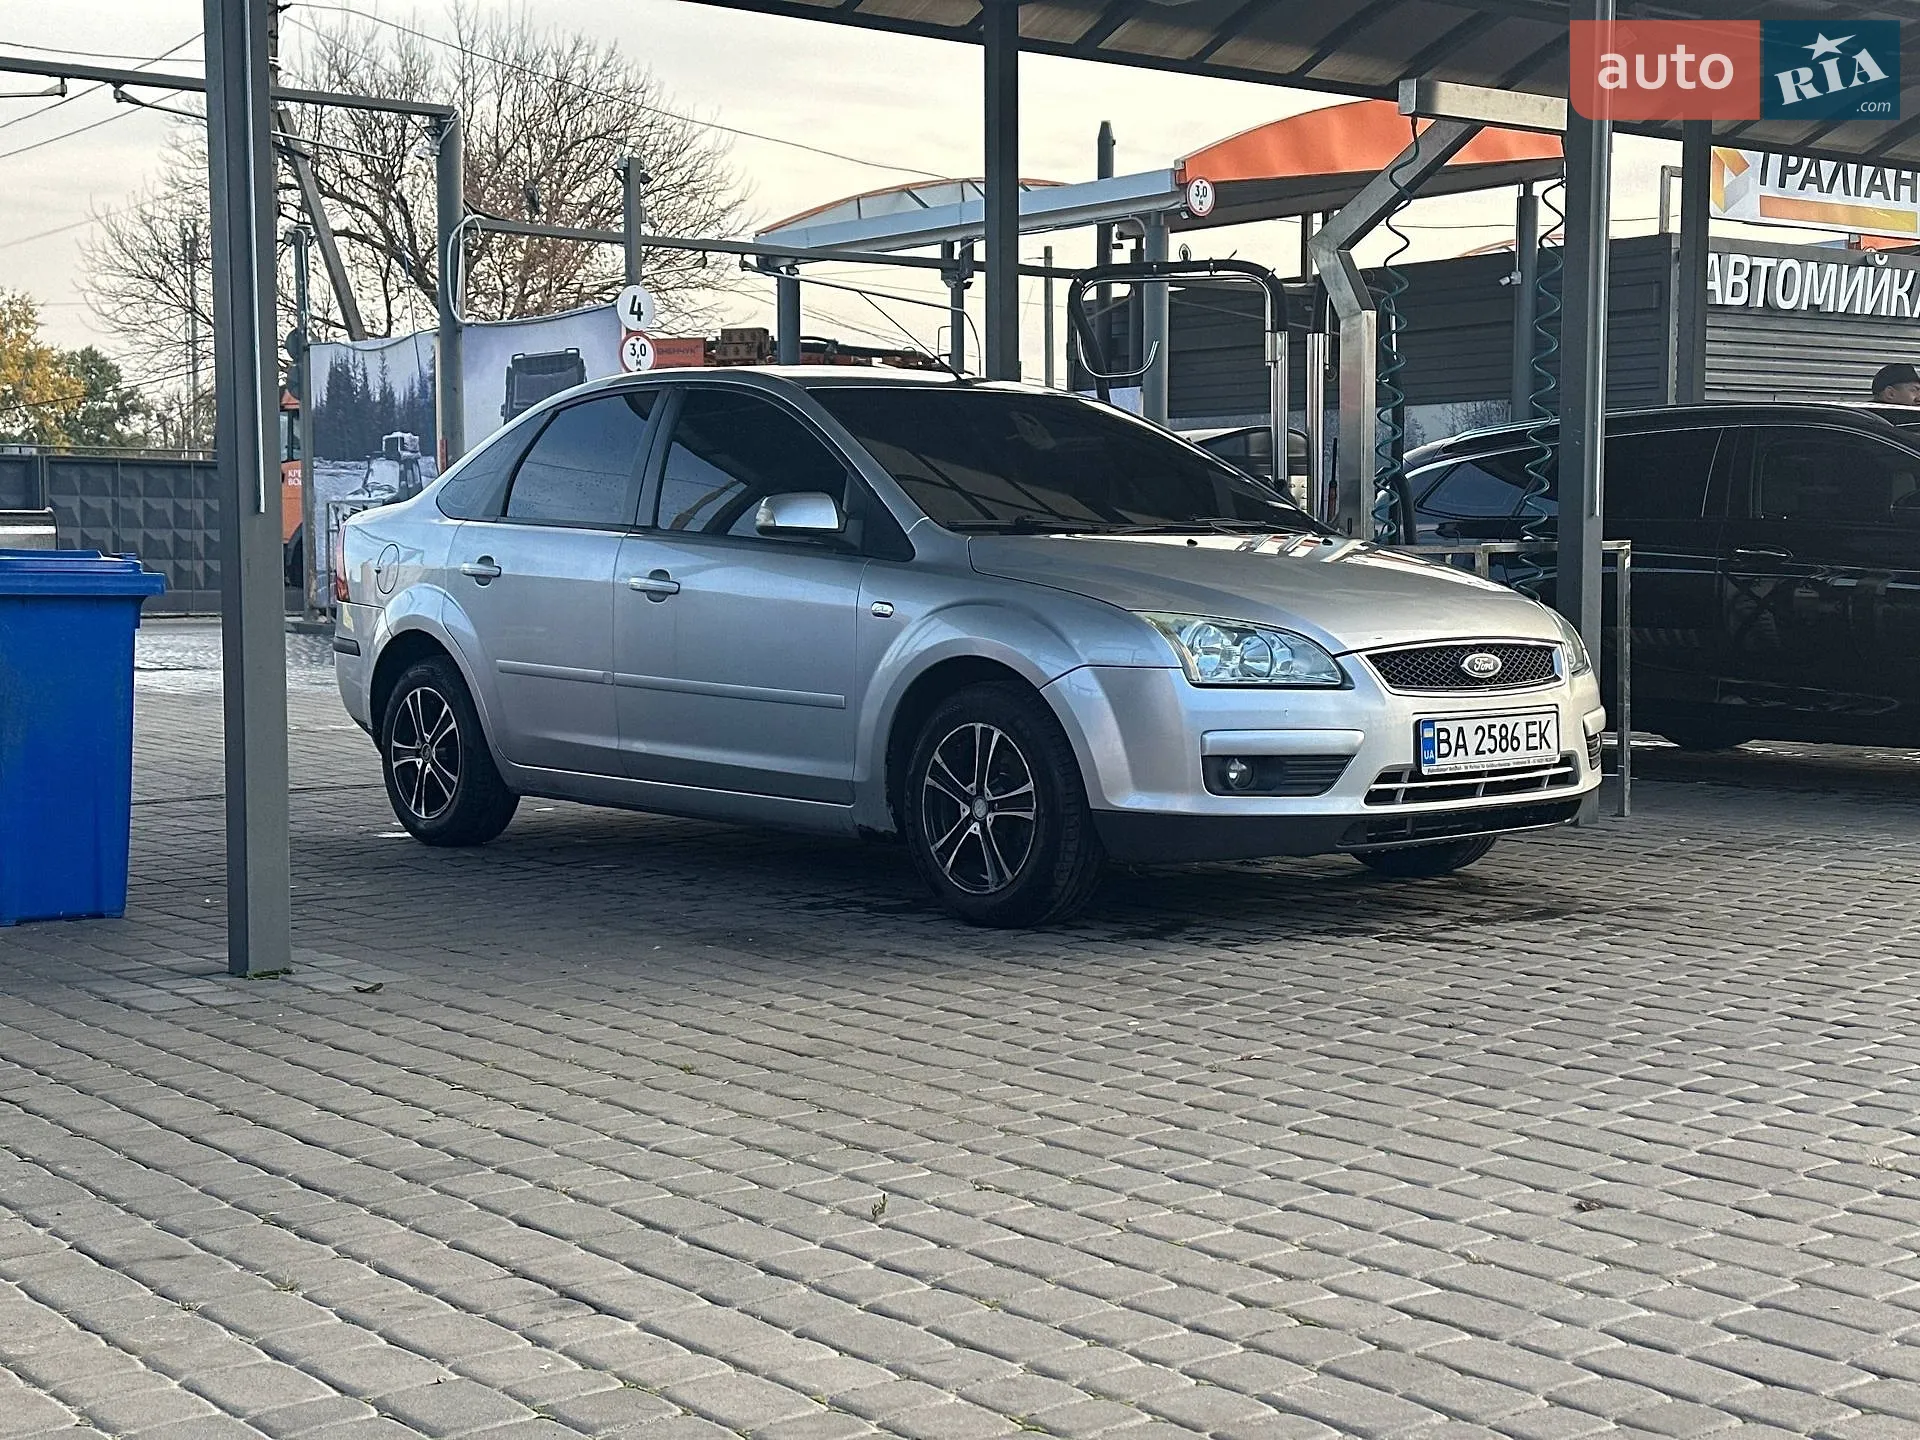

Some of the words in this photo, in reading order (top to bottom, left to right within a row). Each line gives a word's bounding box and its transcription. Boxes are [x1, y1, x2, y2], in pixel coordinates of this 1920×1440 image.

[1194, 185, 1208, 199] 3,0
[1707, 252, 1920, 318] АВТОМИЙК
[629, 294, 643, 322] 4
[630, 342, 647, 360] 3,0
[1473, 657, 1494, 671] Ford
[1436, 726, 1469, 759] BA
[1474, 721, 1521, 756] 2586
[1525, 719, 1552, 751] EK
[1423, 749, 1435, 760] UA
